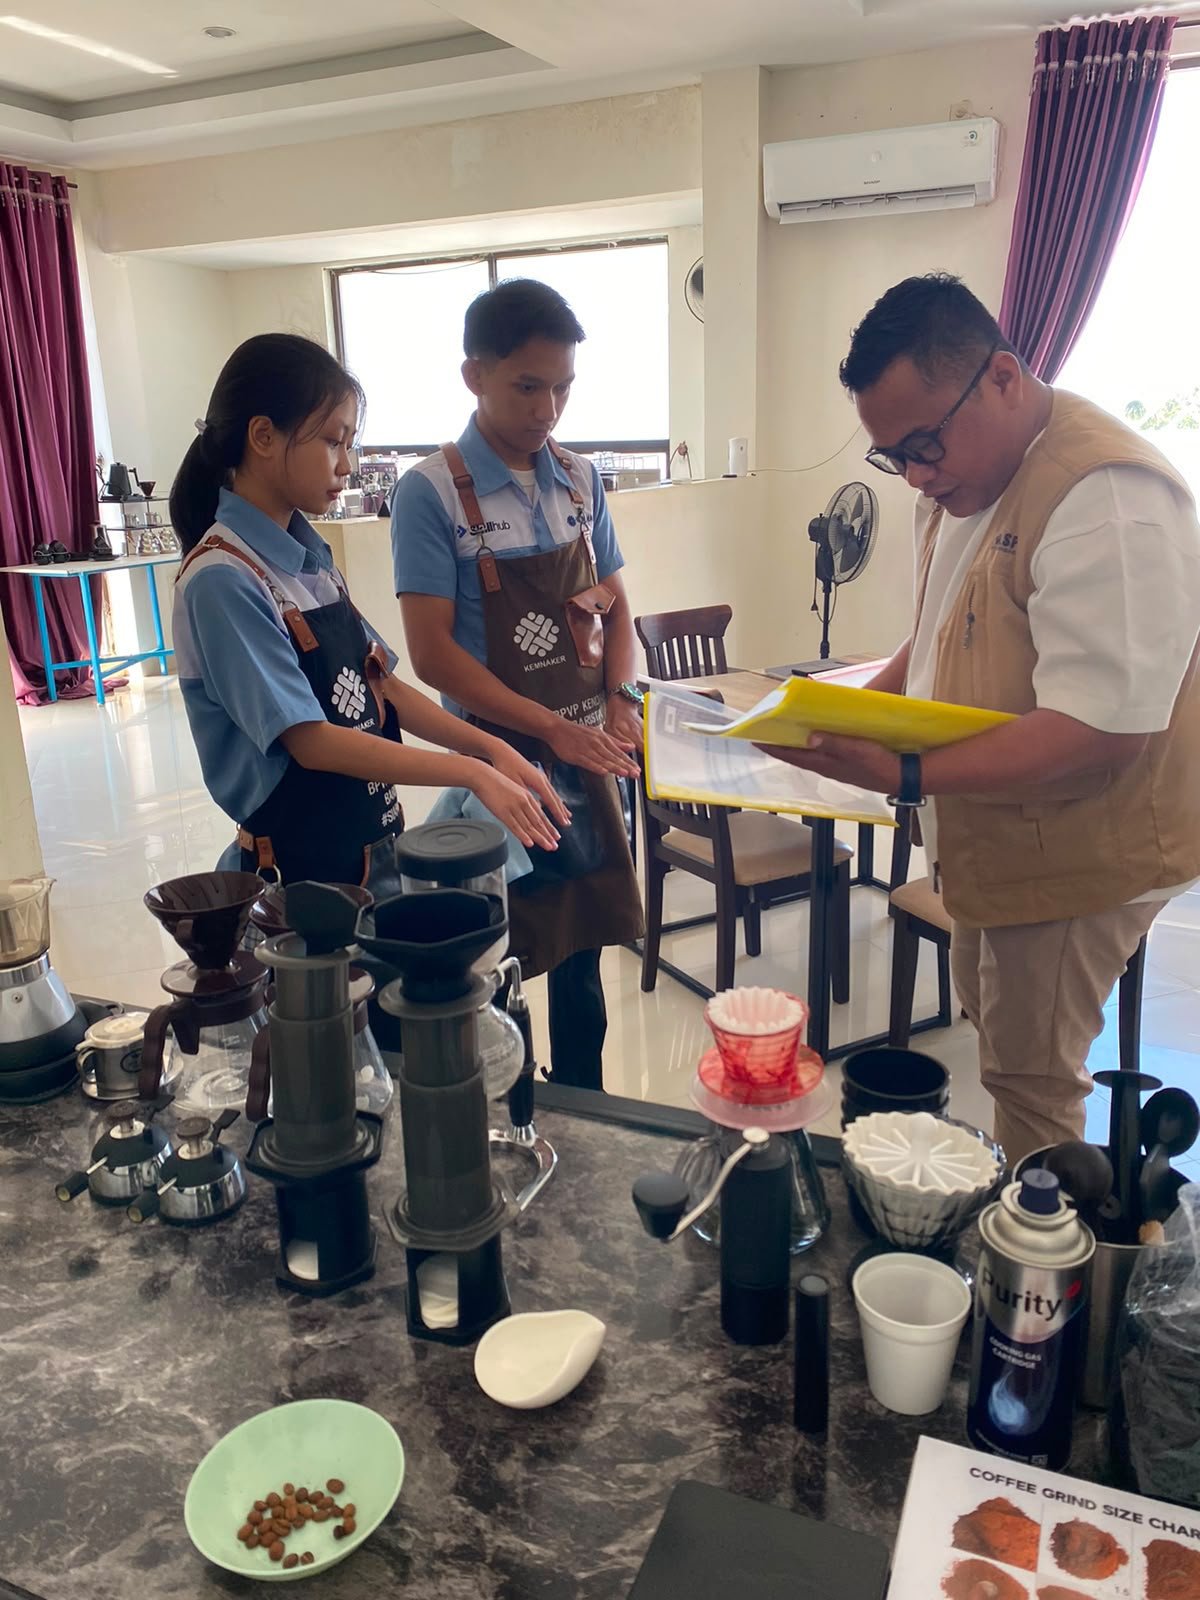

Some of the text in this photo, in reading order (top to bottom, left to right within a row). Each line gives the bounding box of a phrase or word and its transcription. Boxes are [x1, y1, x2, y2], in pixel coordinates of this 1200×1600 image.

[523, 655, 567, 672] KEMNAKER
[982, 1267, 1062, 1321] Purity
[969, 1467, 1037, 1494] COFFEE
[1042, 1487, 1097, 1510] GRIND
[1102, 1504, 1143, 1524] SIZE
